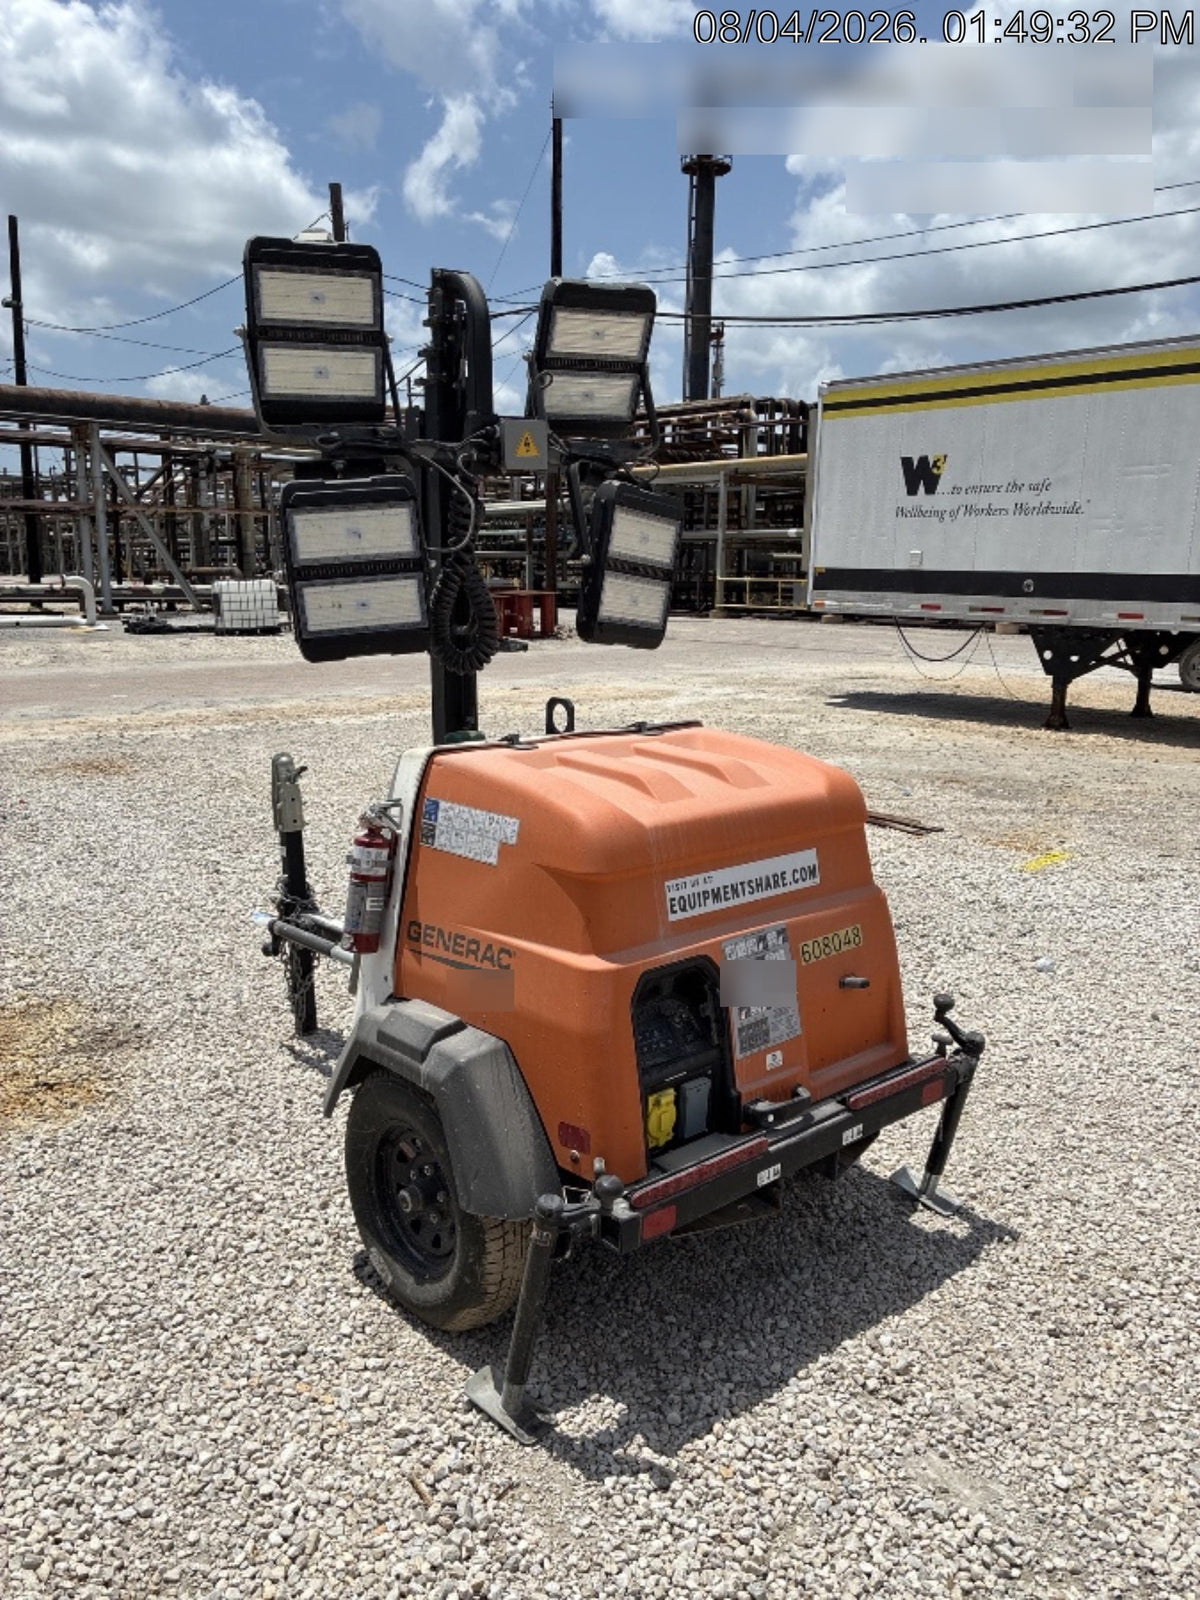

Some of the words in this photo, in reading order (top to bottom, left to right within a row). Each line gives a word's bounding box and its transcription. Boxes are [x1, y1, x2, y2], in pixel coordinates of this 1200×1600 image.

[964, 484, 1004, 495] ensure
[1005, 480, 1025, 493] the
[1028, 477, 1052, 497] safe
[895, 503, 945, 523] Wellbeing
[949, 503, 963, 522] of
[963, 502, 1009, 517] Workers
[669, 863, 818, 915] EQUIPMENTSHARE.COM
[407, 920, 513, 970] GENERAC
[801, 925, 862, 964] 608048
